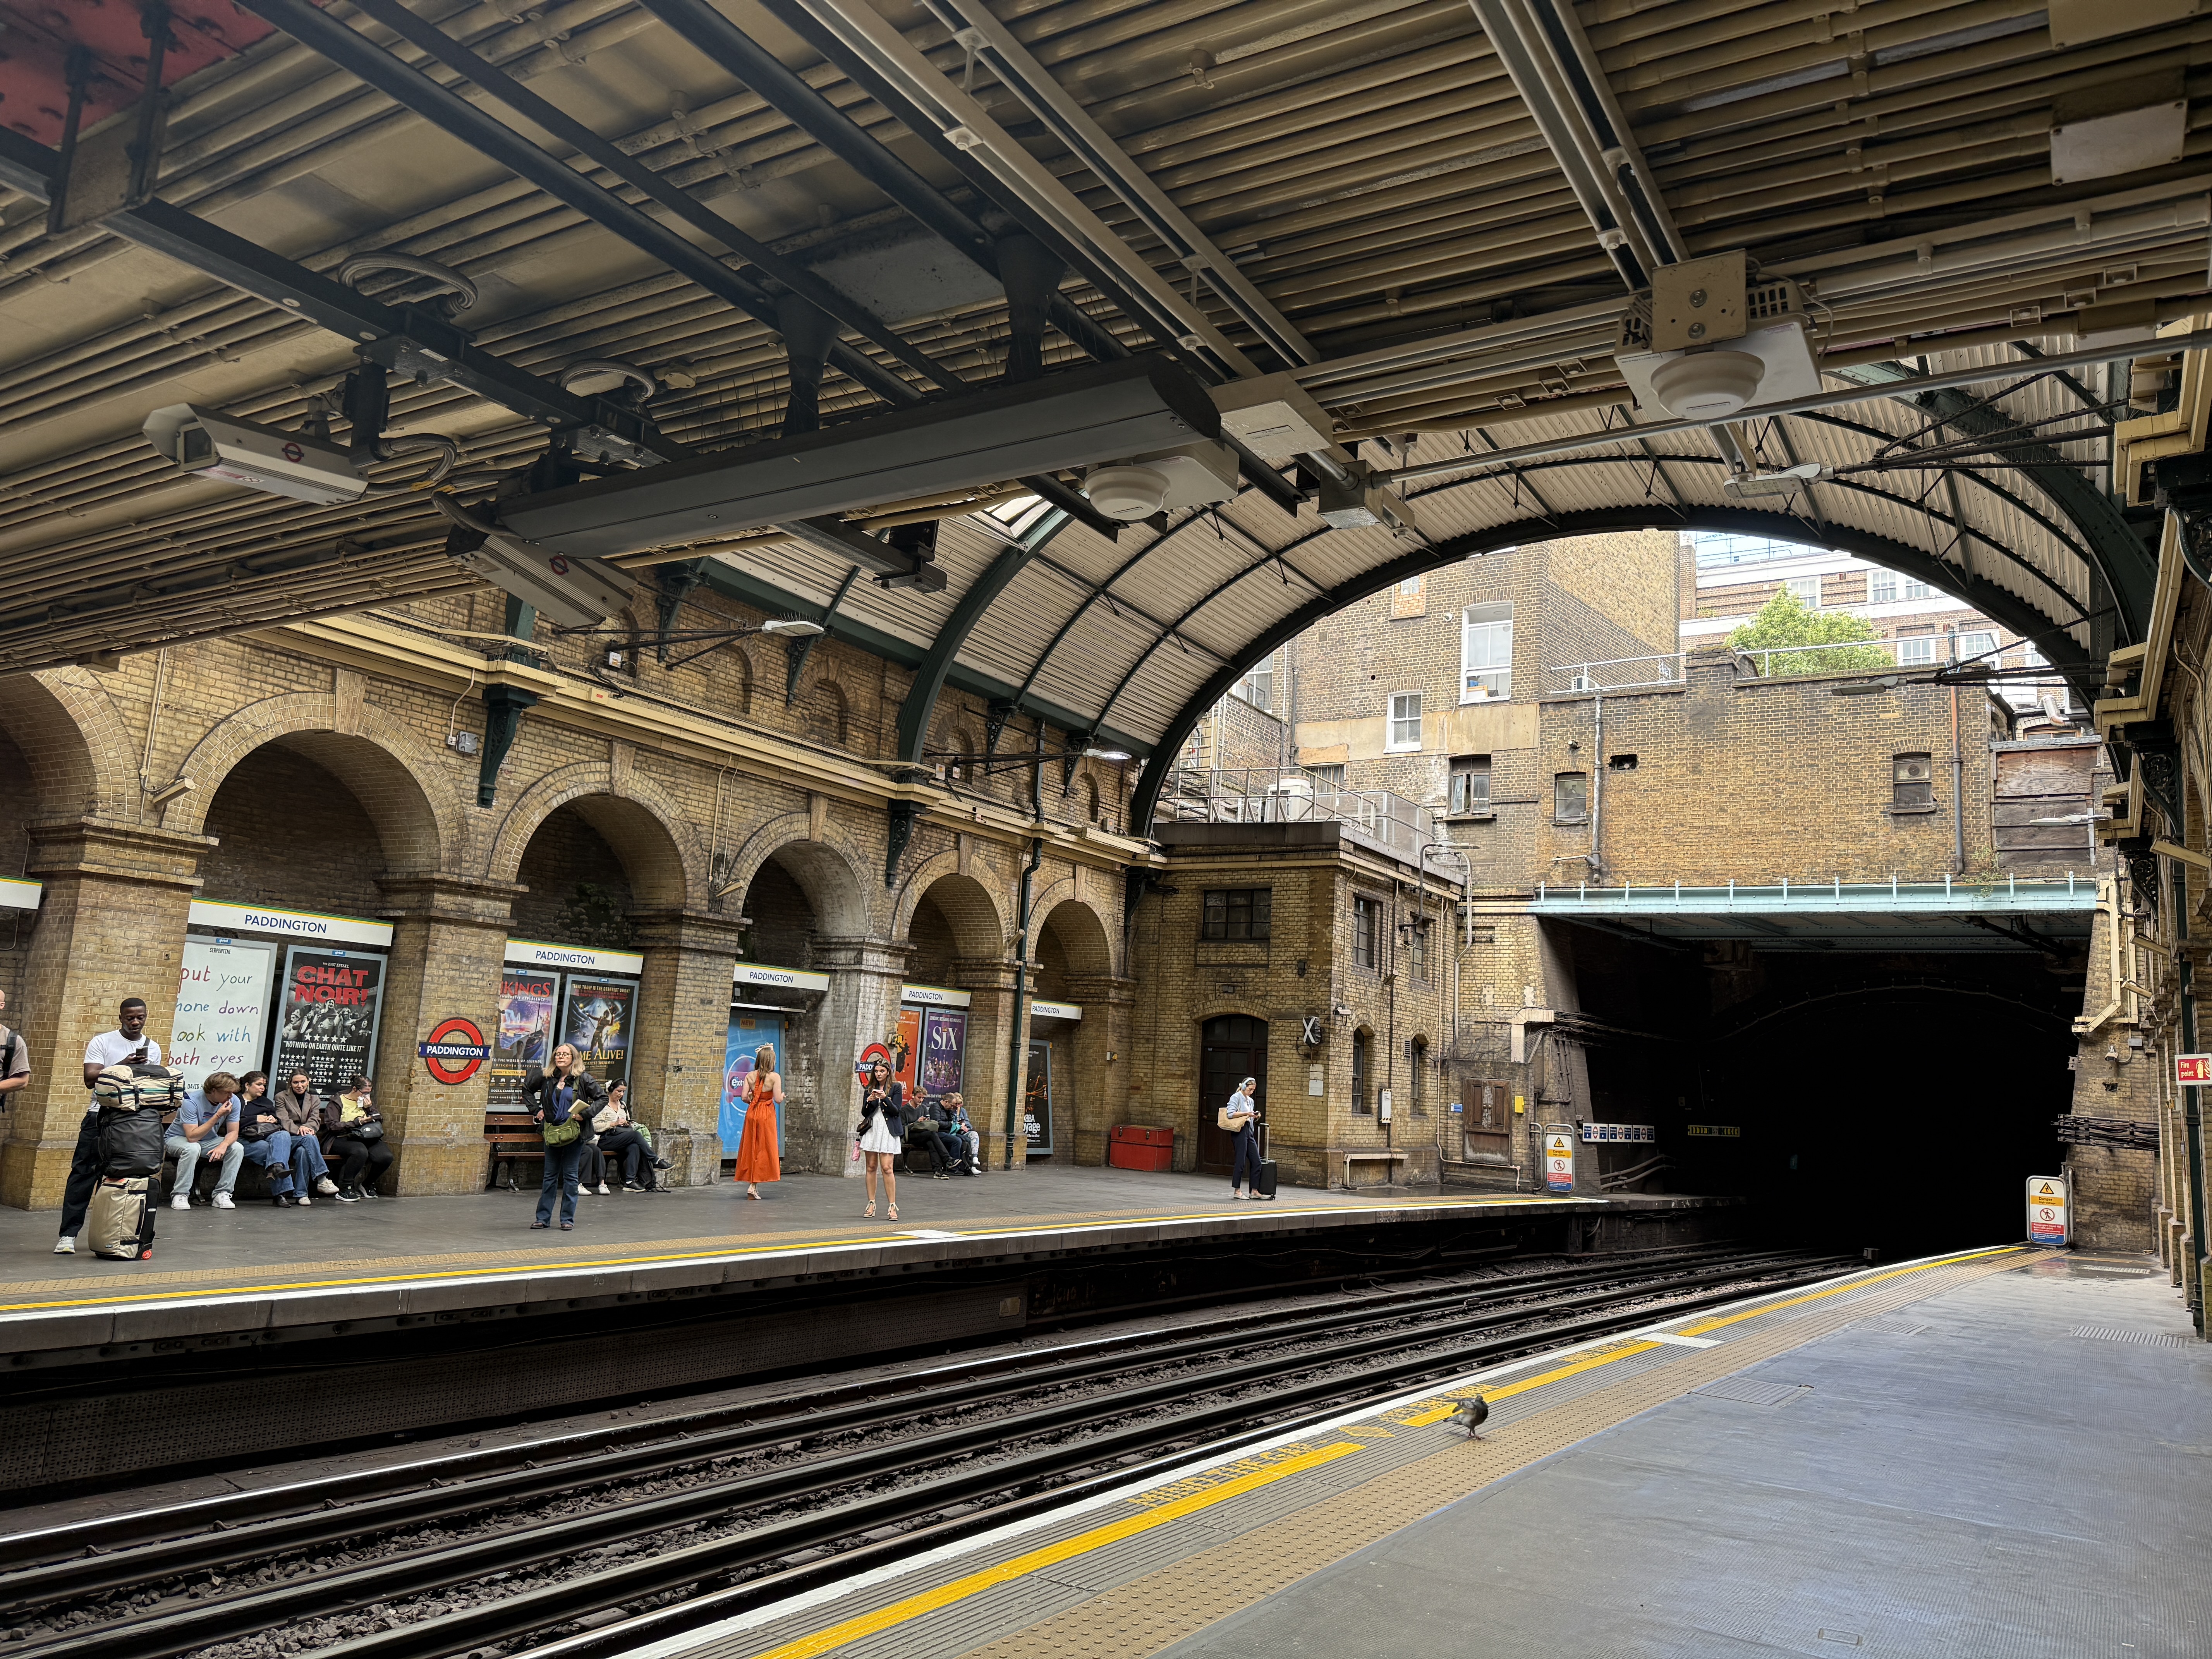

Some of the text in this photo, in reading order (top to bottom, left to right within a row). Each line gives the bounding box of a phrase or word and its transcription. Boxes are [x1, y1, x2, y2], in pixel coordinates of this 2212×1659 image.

[245, 914, 326, 933] PADDINGTON
[536, 950, 595, 964] PADDINGTON
[179, 965, 252, 993] put your
[297, 965, 369, 987] CHAT
[750, 971, 793, 983] PADDINGTON
[295, 984, 369, 1007] NOIR!
[500, 981, 551, 998] IKINGS
[909, 991, 943, 1000] PADDINGTON
[219, 1000, 258, 1014] down
[1032, 1005, 1060, 1014] PADDINGTON
[176, 1023, 251, 1042] ook with
[426, 1045, 483, 1056] PADDINGTON
[594, 1048, 624, 1060] ALIVE!
[167, 1047, 244, 1071] both eyes
[2181, 1070, 2194, 1078] point
[1126, 1477, 1219, 1508] MIND
[1204, 1458, 1275, 1478] THE
